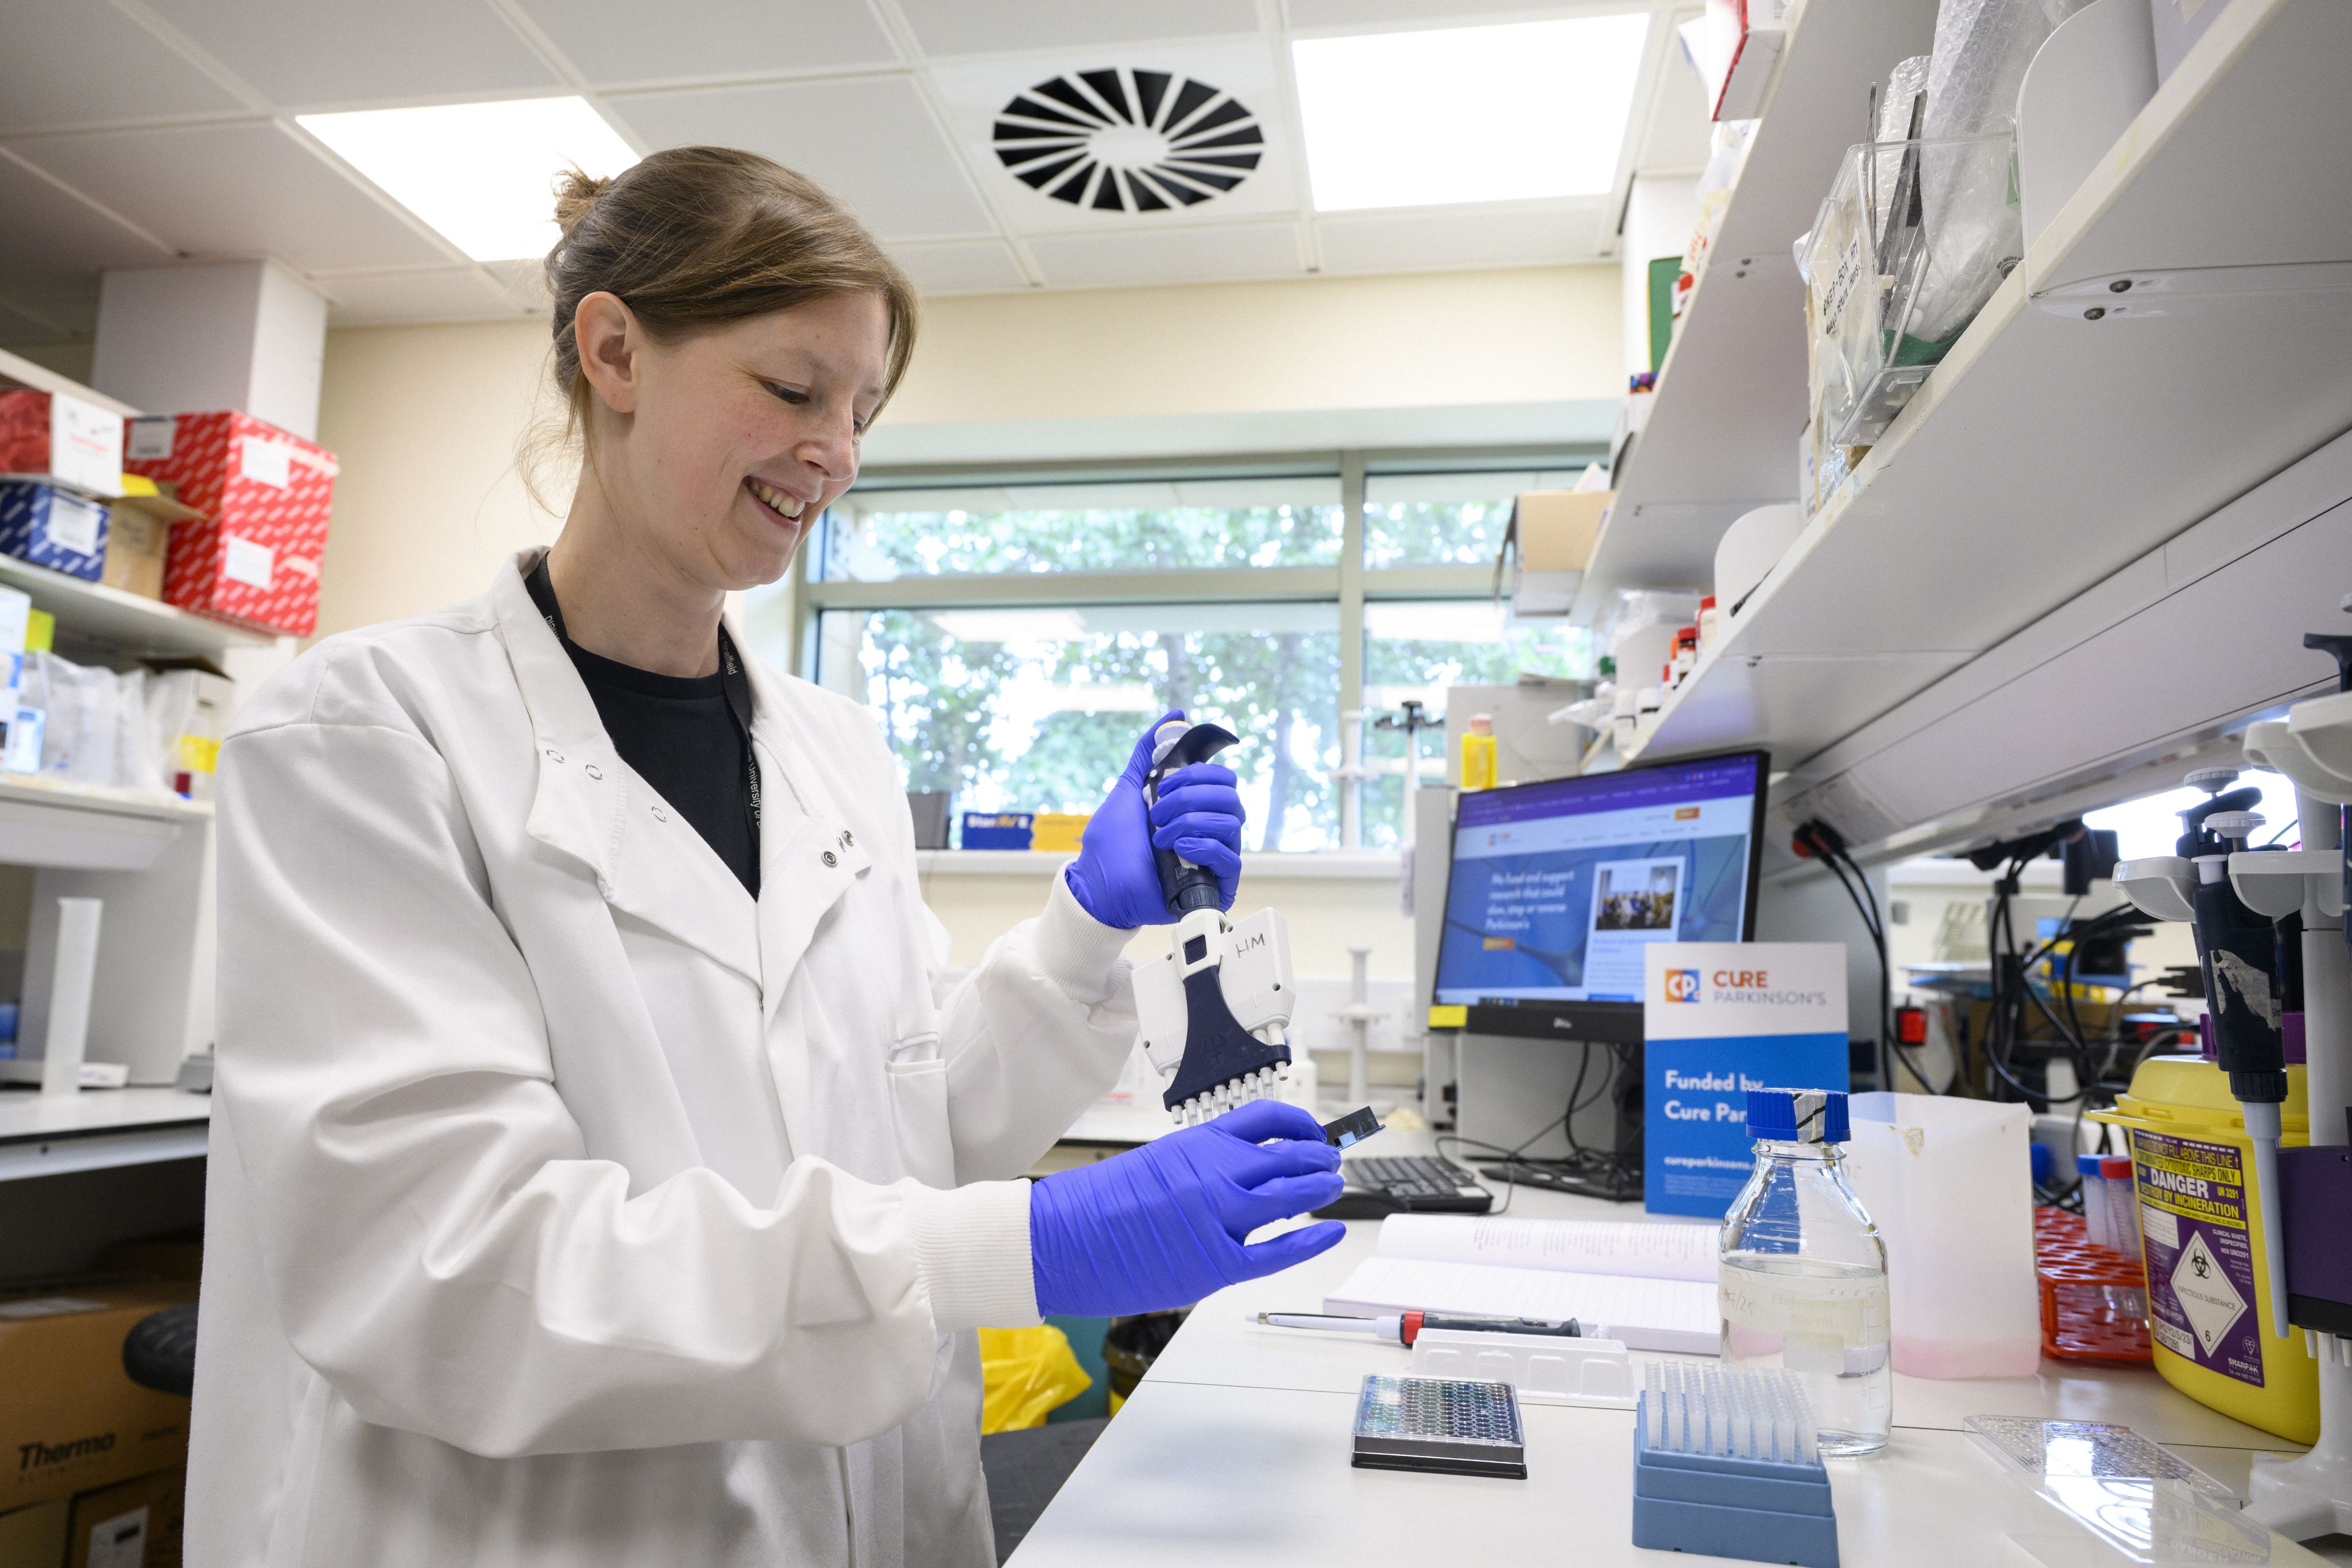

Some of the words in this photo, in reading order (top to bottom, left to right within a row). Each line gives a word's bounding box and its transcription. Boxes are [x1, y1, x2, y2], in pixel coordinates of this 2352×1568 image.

[1823, 258, 1849, 316] PREP-BOX
[1850, 239, 1858, 262] HM
[1837, 288, 1849, 315] return
[748, 762, 760, 808] University
[1713, 970, 1768, 988] CURE
[1714, 989, 1827, 1006] PARKINSON'S
[1666, 1070, 1735, 1091] Funded
[1665, 1100, 1711, 1121] Cure
[2169, 1144, 2180, 1159] FILL
[2180, 1147, 2200, 1163] ABOVE
[2200, 1151, 2216, 1166] THIS
[2217, 1153, 2233, 1168] LINE
[2150, 1167, 2209, 1199] DANGER
[2225, 1187, 2239, 1199] 3291
[2192, 1164, 2216, 1180] SHARPS
[2218, 1168, 2235, 1184] ONLY
[2164, 1189, 2173, 1203] BY
[2174, 1192, 2239, 1219] INCINERATION
[2212, 1229, 2231, 1238] CLINICAL
[2226, 1219, 2242, 1228] RECORD
[2230, 1249, 2249, 1259] UN3291
[2178, 1286, 2204, 1301] INFECTIOUS
[2204, 1295, 2236, 1311] SUBSTANCE
[2205, 1330, 2211, 1342] 6
[2228, 1357, 2258, 1373] SHARPAK
[19, 1433, 115, 1470] Thermo
